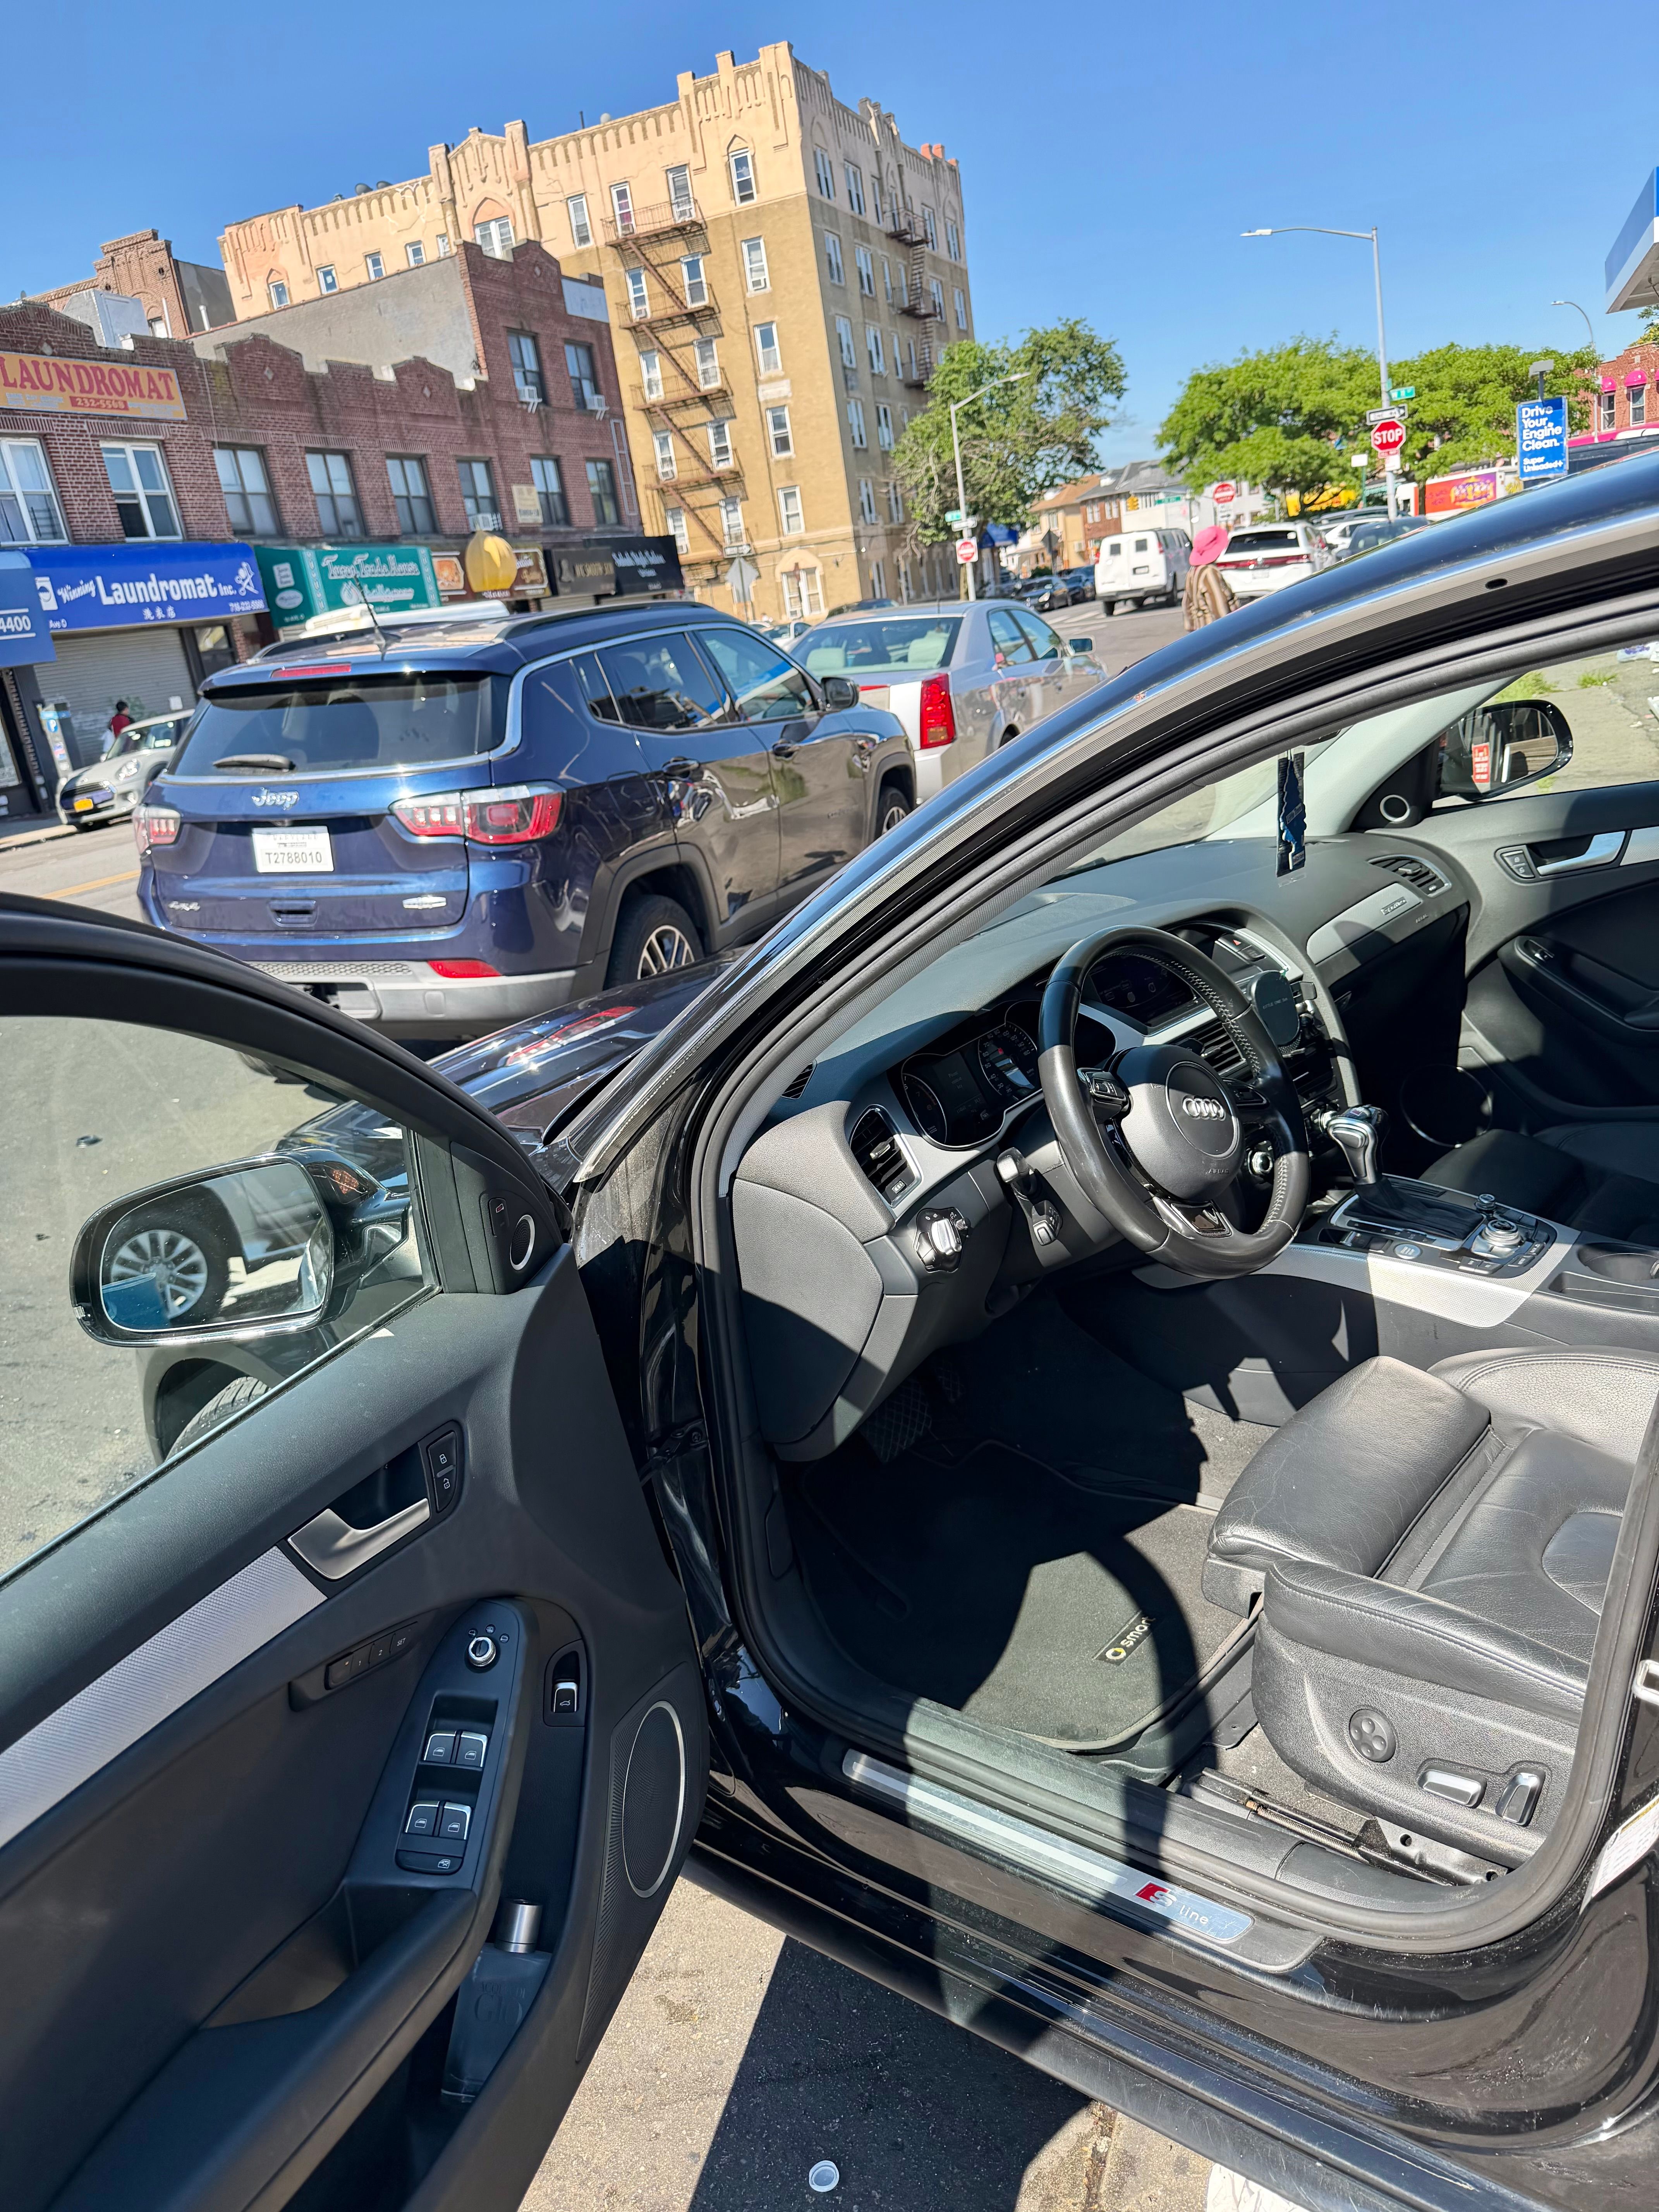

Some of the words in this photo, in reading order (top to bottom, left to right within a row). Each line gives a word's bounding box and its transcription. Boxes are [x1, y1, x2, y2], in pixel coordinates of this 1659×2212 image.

[0, 356, 175, 400] LAUNDROMAT
[1522, 405, 1553, 418] Drive
[1522, 417, 1548, 429] Your
[1374, 428, 1402, 445] STOP
[1523, 425, 1562, 440] Engine
[1522, 438, 1560, 452] Clean.
[1523, 456, 1545, 466] Super
[57, 579, 96, 604] Winning
[96, 573, 218, 605] Laundromat
[218, 583, 237, 597] Inc.
[252, 787, 299, 810] Jeep
[265, 851, 322, 864] T2788010
[1120, 1616, 1156, 1647] smart
[397, 1637, 406, 1646] SET
[1149, 1891, 1177, 1907] S
[1180, 1905, 1209, 1925] line
